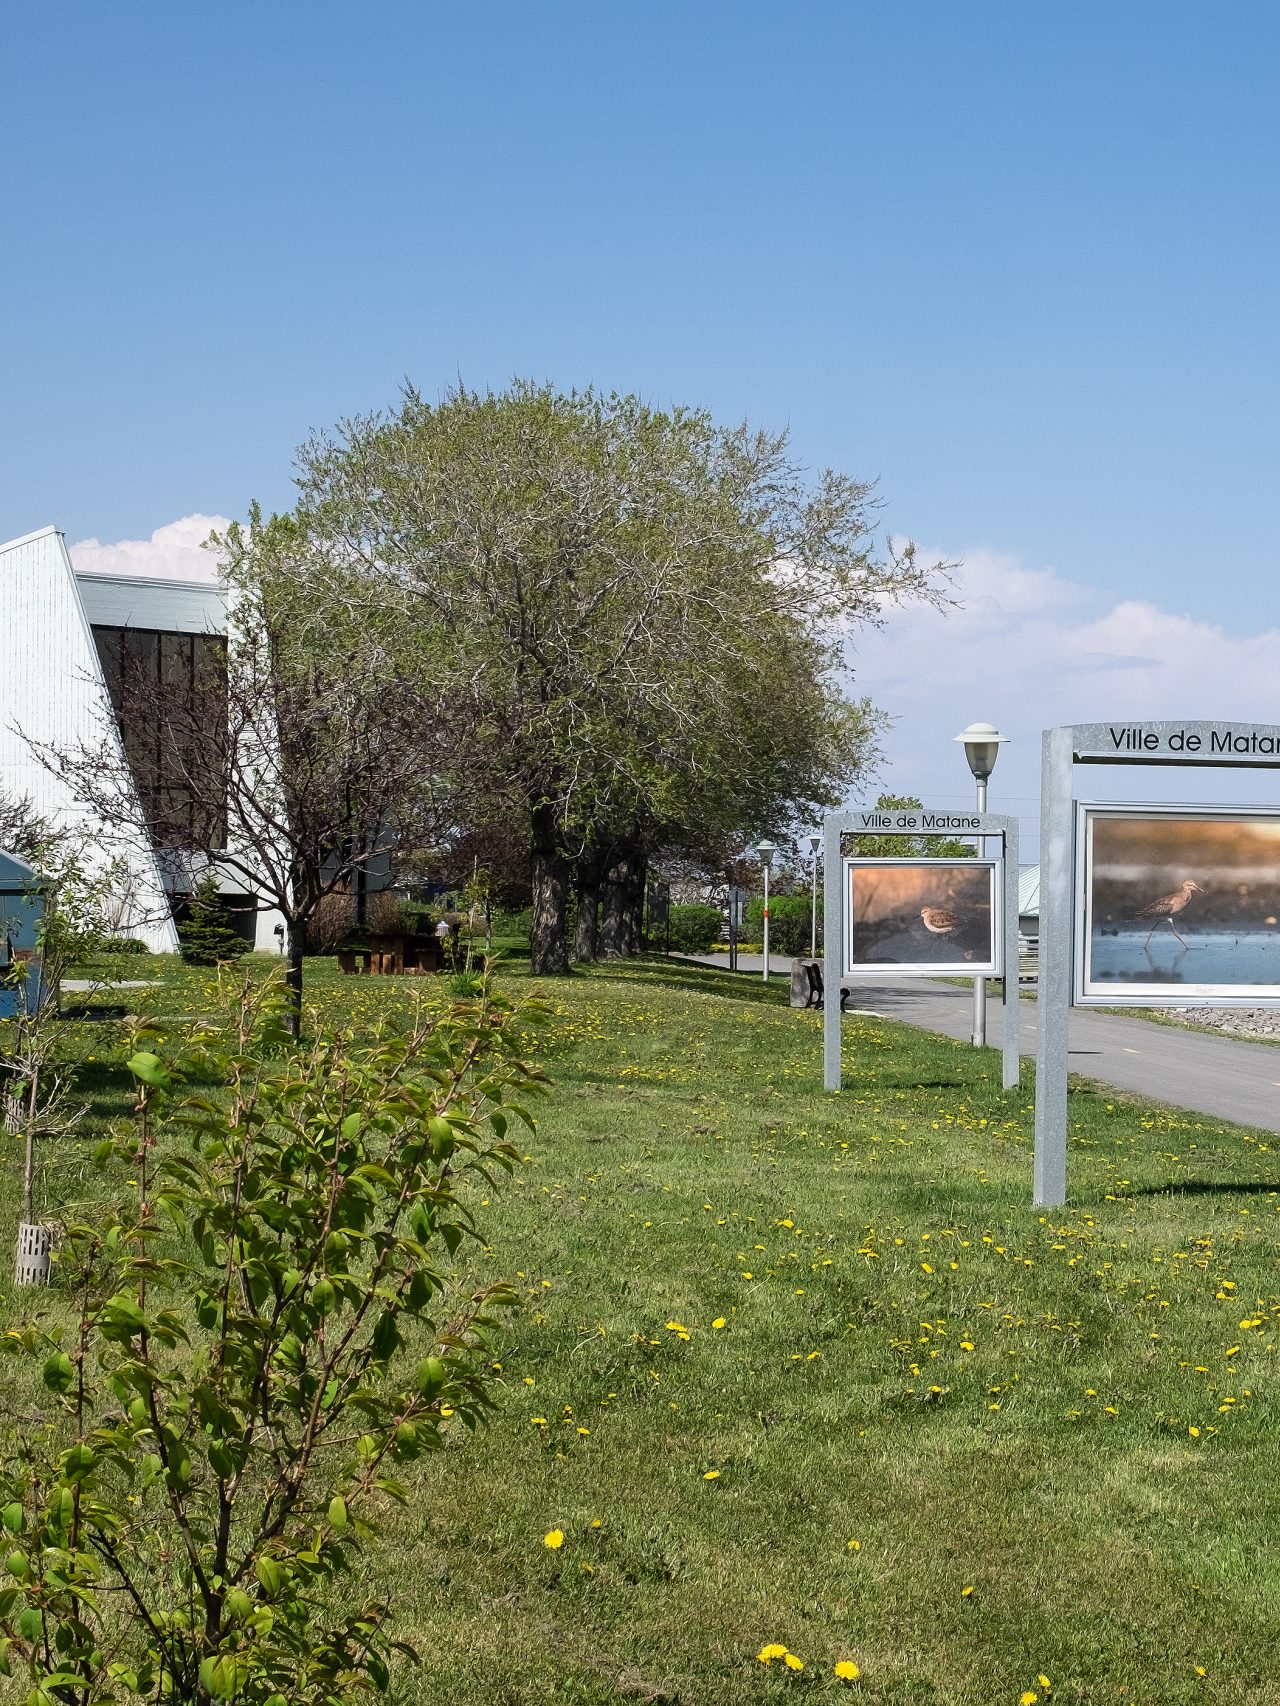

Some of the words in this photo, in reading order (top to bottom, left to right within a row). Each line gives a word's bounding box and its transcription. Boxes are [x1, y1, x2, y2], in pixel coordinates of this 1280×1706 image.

[1109, 727, 1160, 751] Ville
[1168, 729, 1202, 752] de
[861, 814, 892, 828] Ville
[896, 814, 917, 828] de
[921, 814, 981, 828] Matane
